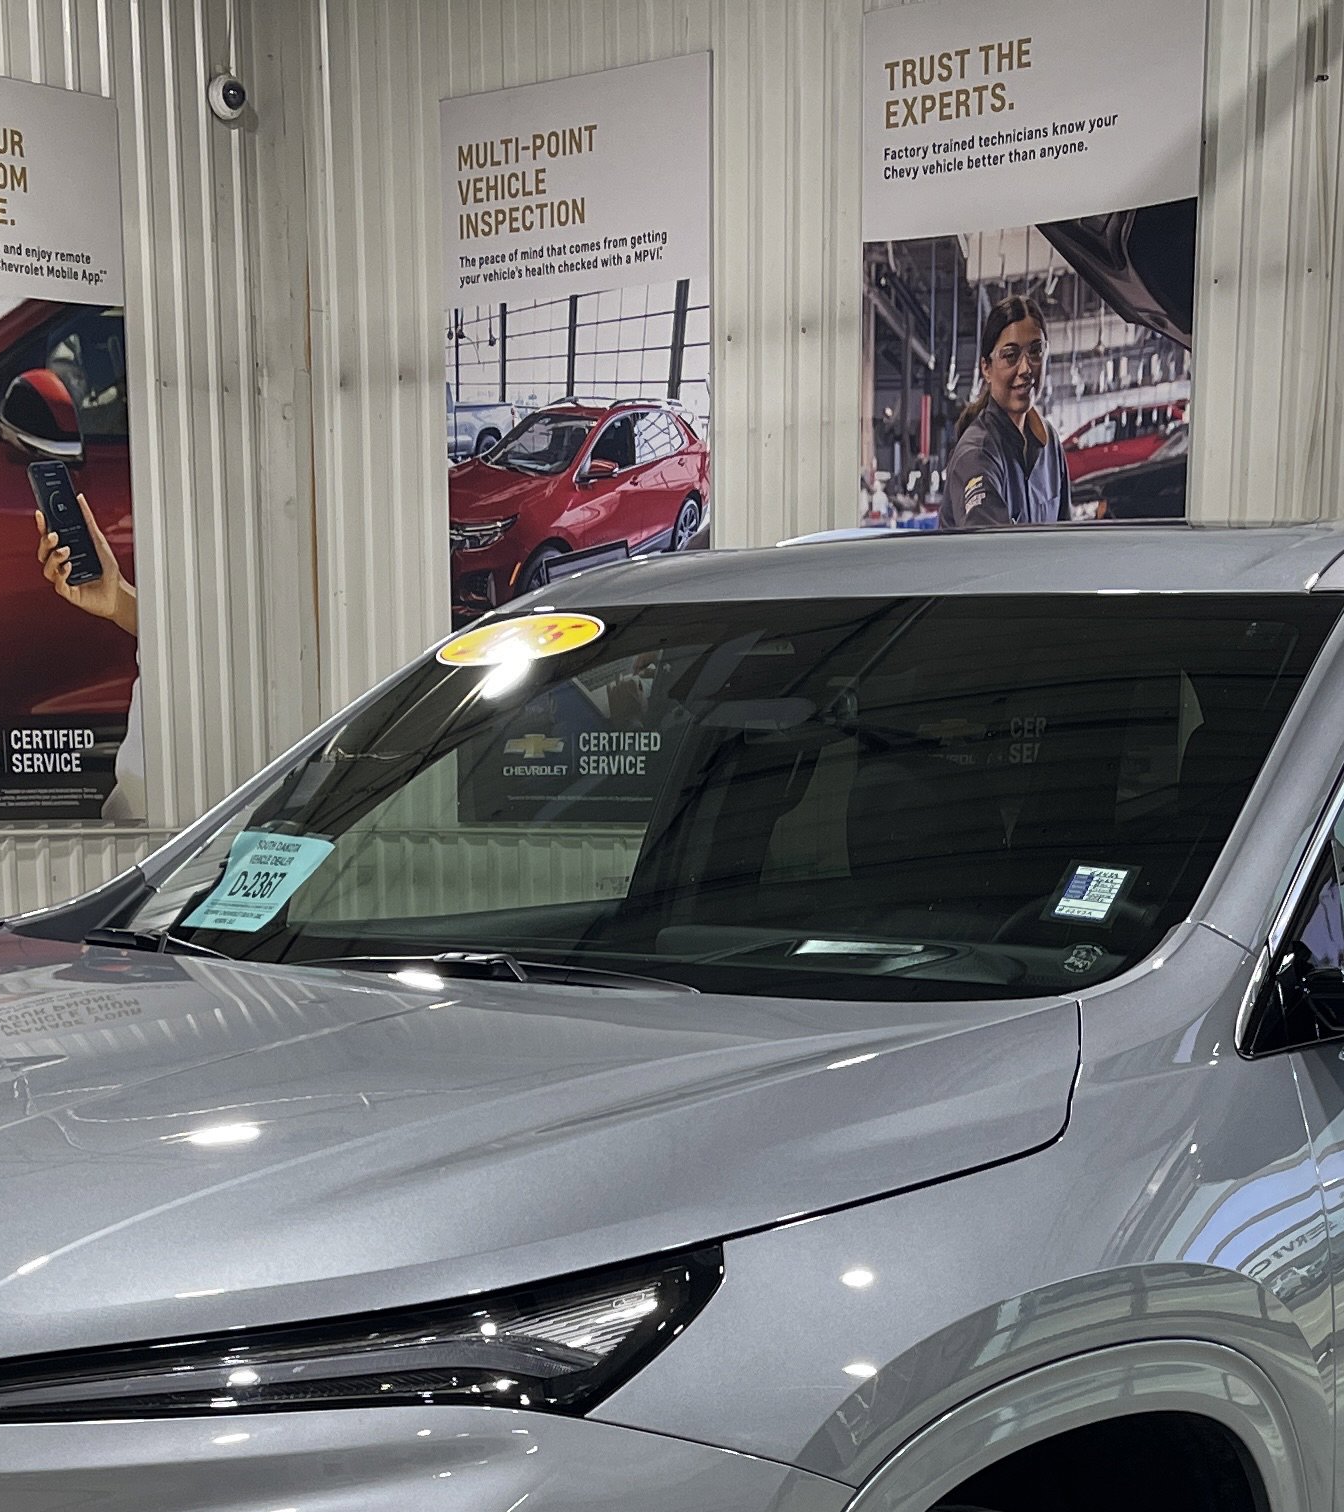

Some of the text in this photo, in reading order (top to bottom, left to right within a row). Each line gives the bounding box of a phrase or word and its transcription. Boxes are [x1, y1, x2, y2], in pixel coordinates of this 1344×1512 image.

[884, 37, 1032, 91] TRUST THE
[885, 82, 1015, 130] EXPERTS.
[458, 124, 598, 172] MULTI-POINT
[883, 113, 1119, 162] Factory trained technicians know your
[883, 140, 1089, 180] Chevy vehicle better than anyone.
[457, 168, 547, 206] VEHICLE
[459, 197, 586, 240] INSPECTION
[3, 241, 23, 257] and
[25, 246, 53, 264] enjoy
[54, 250, 91, 265] remote
[459, 230, 668, 270] The peace of mind that comes from getting
[47, 264, 79, 281] Mobile
[459, 273, 480, 289] your
[482, 266, 523, 283] vehicle's
[525, 263, 556, 279] health
[557, 258, 599, 275] checked
[600, 252, 623, 268] with
[625, 255, 632, 265] a
[10, 729, 95, 750] CERTIFIED
[579, 731, 662, 752] CERTIFIED
[11, 752, 83, 773] SERVICE
[503, 765, 568, 777] CHEVROLET
[579, 755, 646, 776] SERVICE
[227, 870, 288, 899] D-2367
